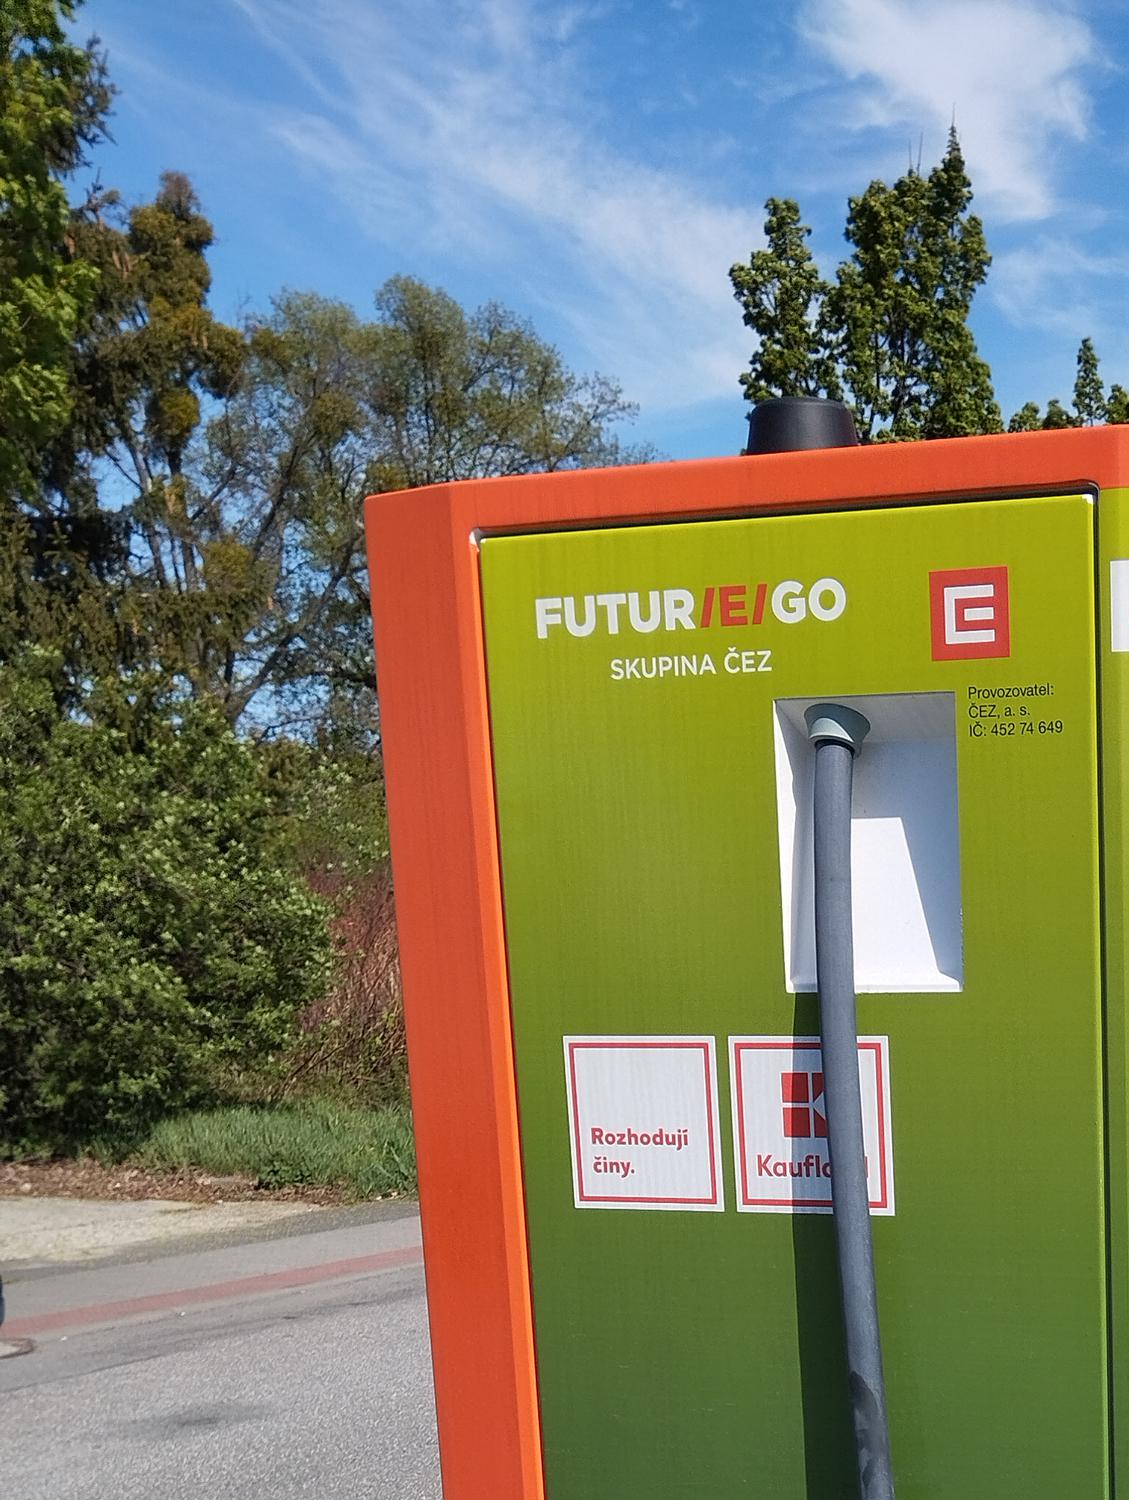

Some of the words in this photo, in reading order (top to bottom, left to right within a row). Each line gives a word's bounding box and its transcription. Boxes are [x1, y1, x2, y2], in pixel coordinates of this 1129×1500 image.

[610, 653, 717, 680] SKUPINA
[724, 646, 773, 674] ČEZ
[968, 683, 1054, 699] Provozovatel:
[968, 703, 1000, 719] ČEZ,
[1004, 706, 1016, 717] a.
[1019, 705, 1031, 716] s.
[969, 721, 987, 737] IČ:
[990, 722, 1016, 736] 452
[1019, 721, 1034, 735] 74
[1038, 720, 1063, 734] 649
[590, 1127, 689, 1150] Rozhodují
[593, 1156, 636, 1179] činy.
